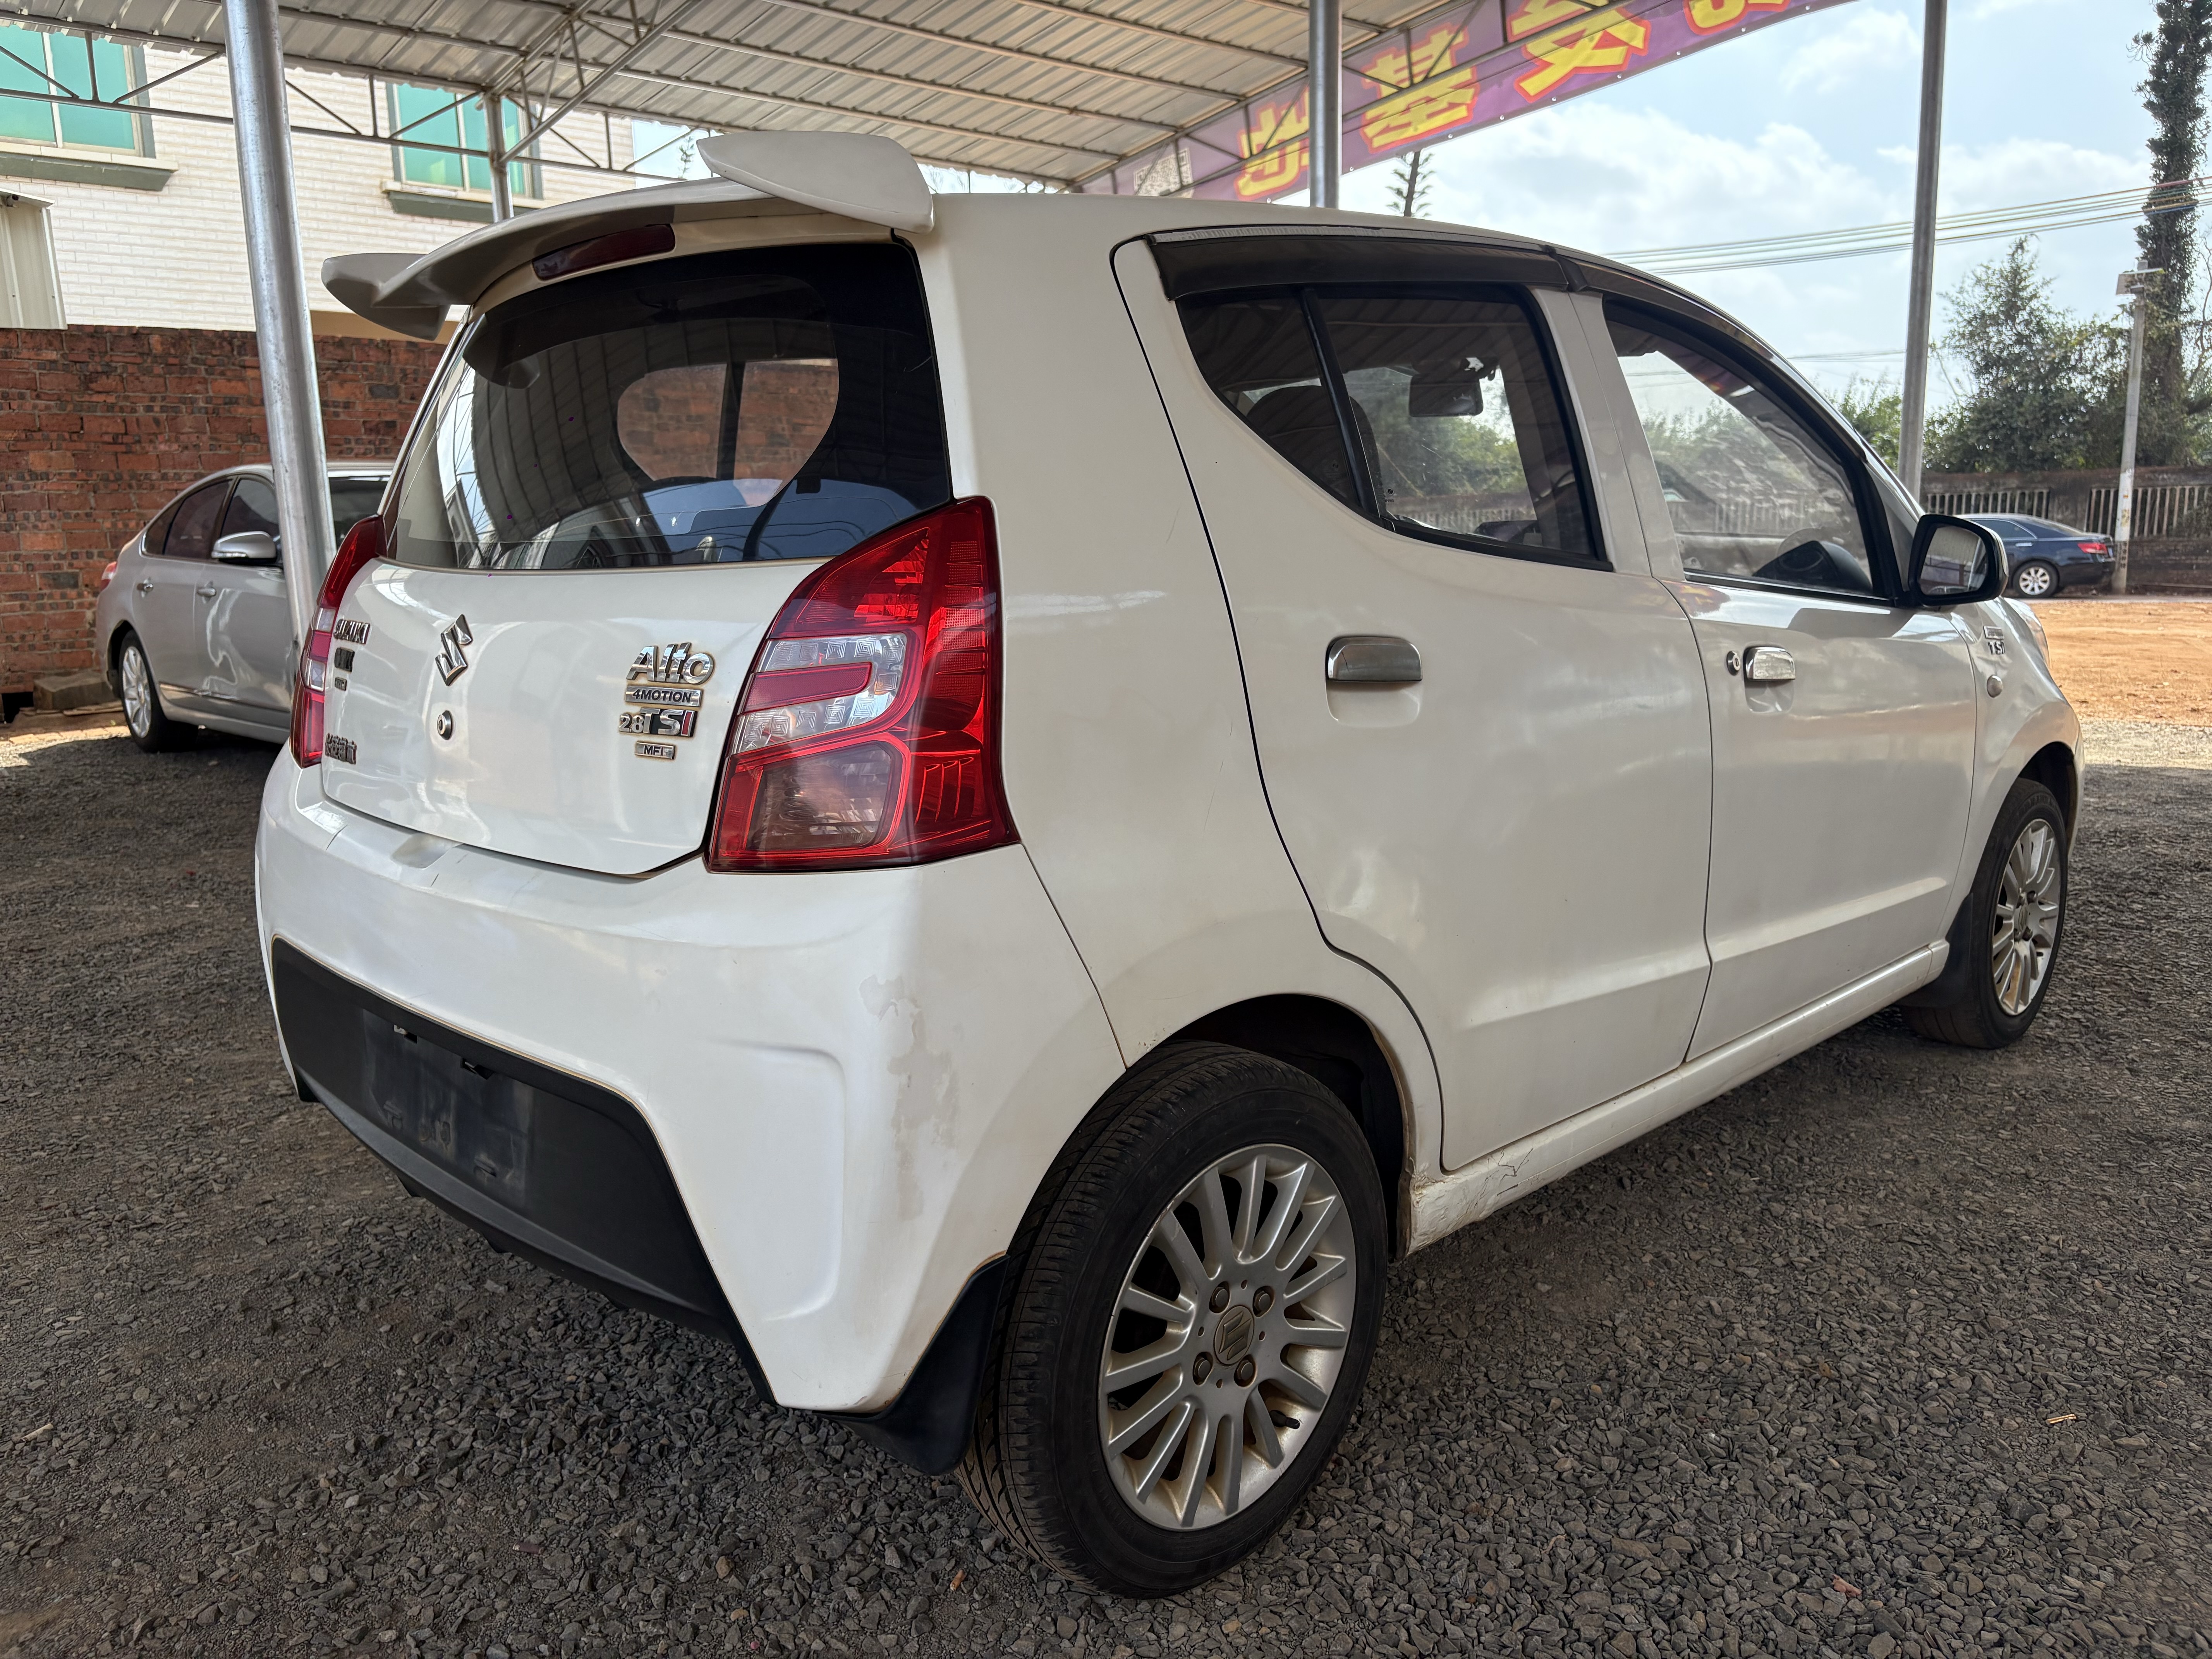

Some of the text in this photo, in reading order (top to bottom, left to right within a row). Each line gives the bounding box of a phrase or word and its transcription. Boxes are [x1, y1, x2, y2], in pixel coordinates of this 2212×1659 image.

[1988, 641, 2005, 655] TSI
[626, 642, 714, 685] Alto
[633, 689, 692, 703] 4MOTION
[644, 745, 664, 756] MFI
